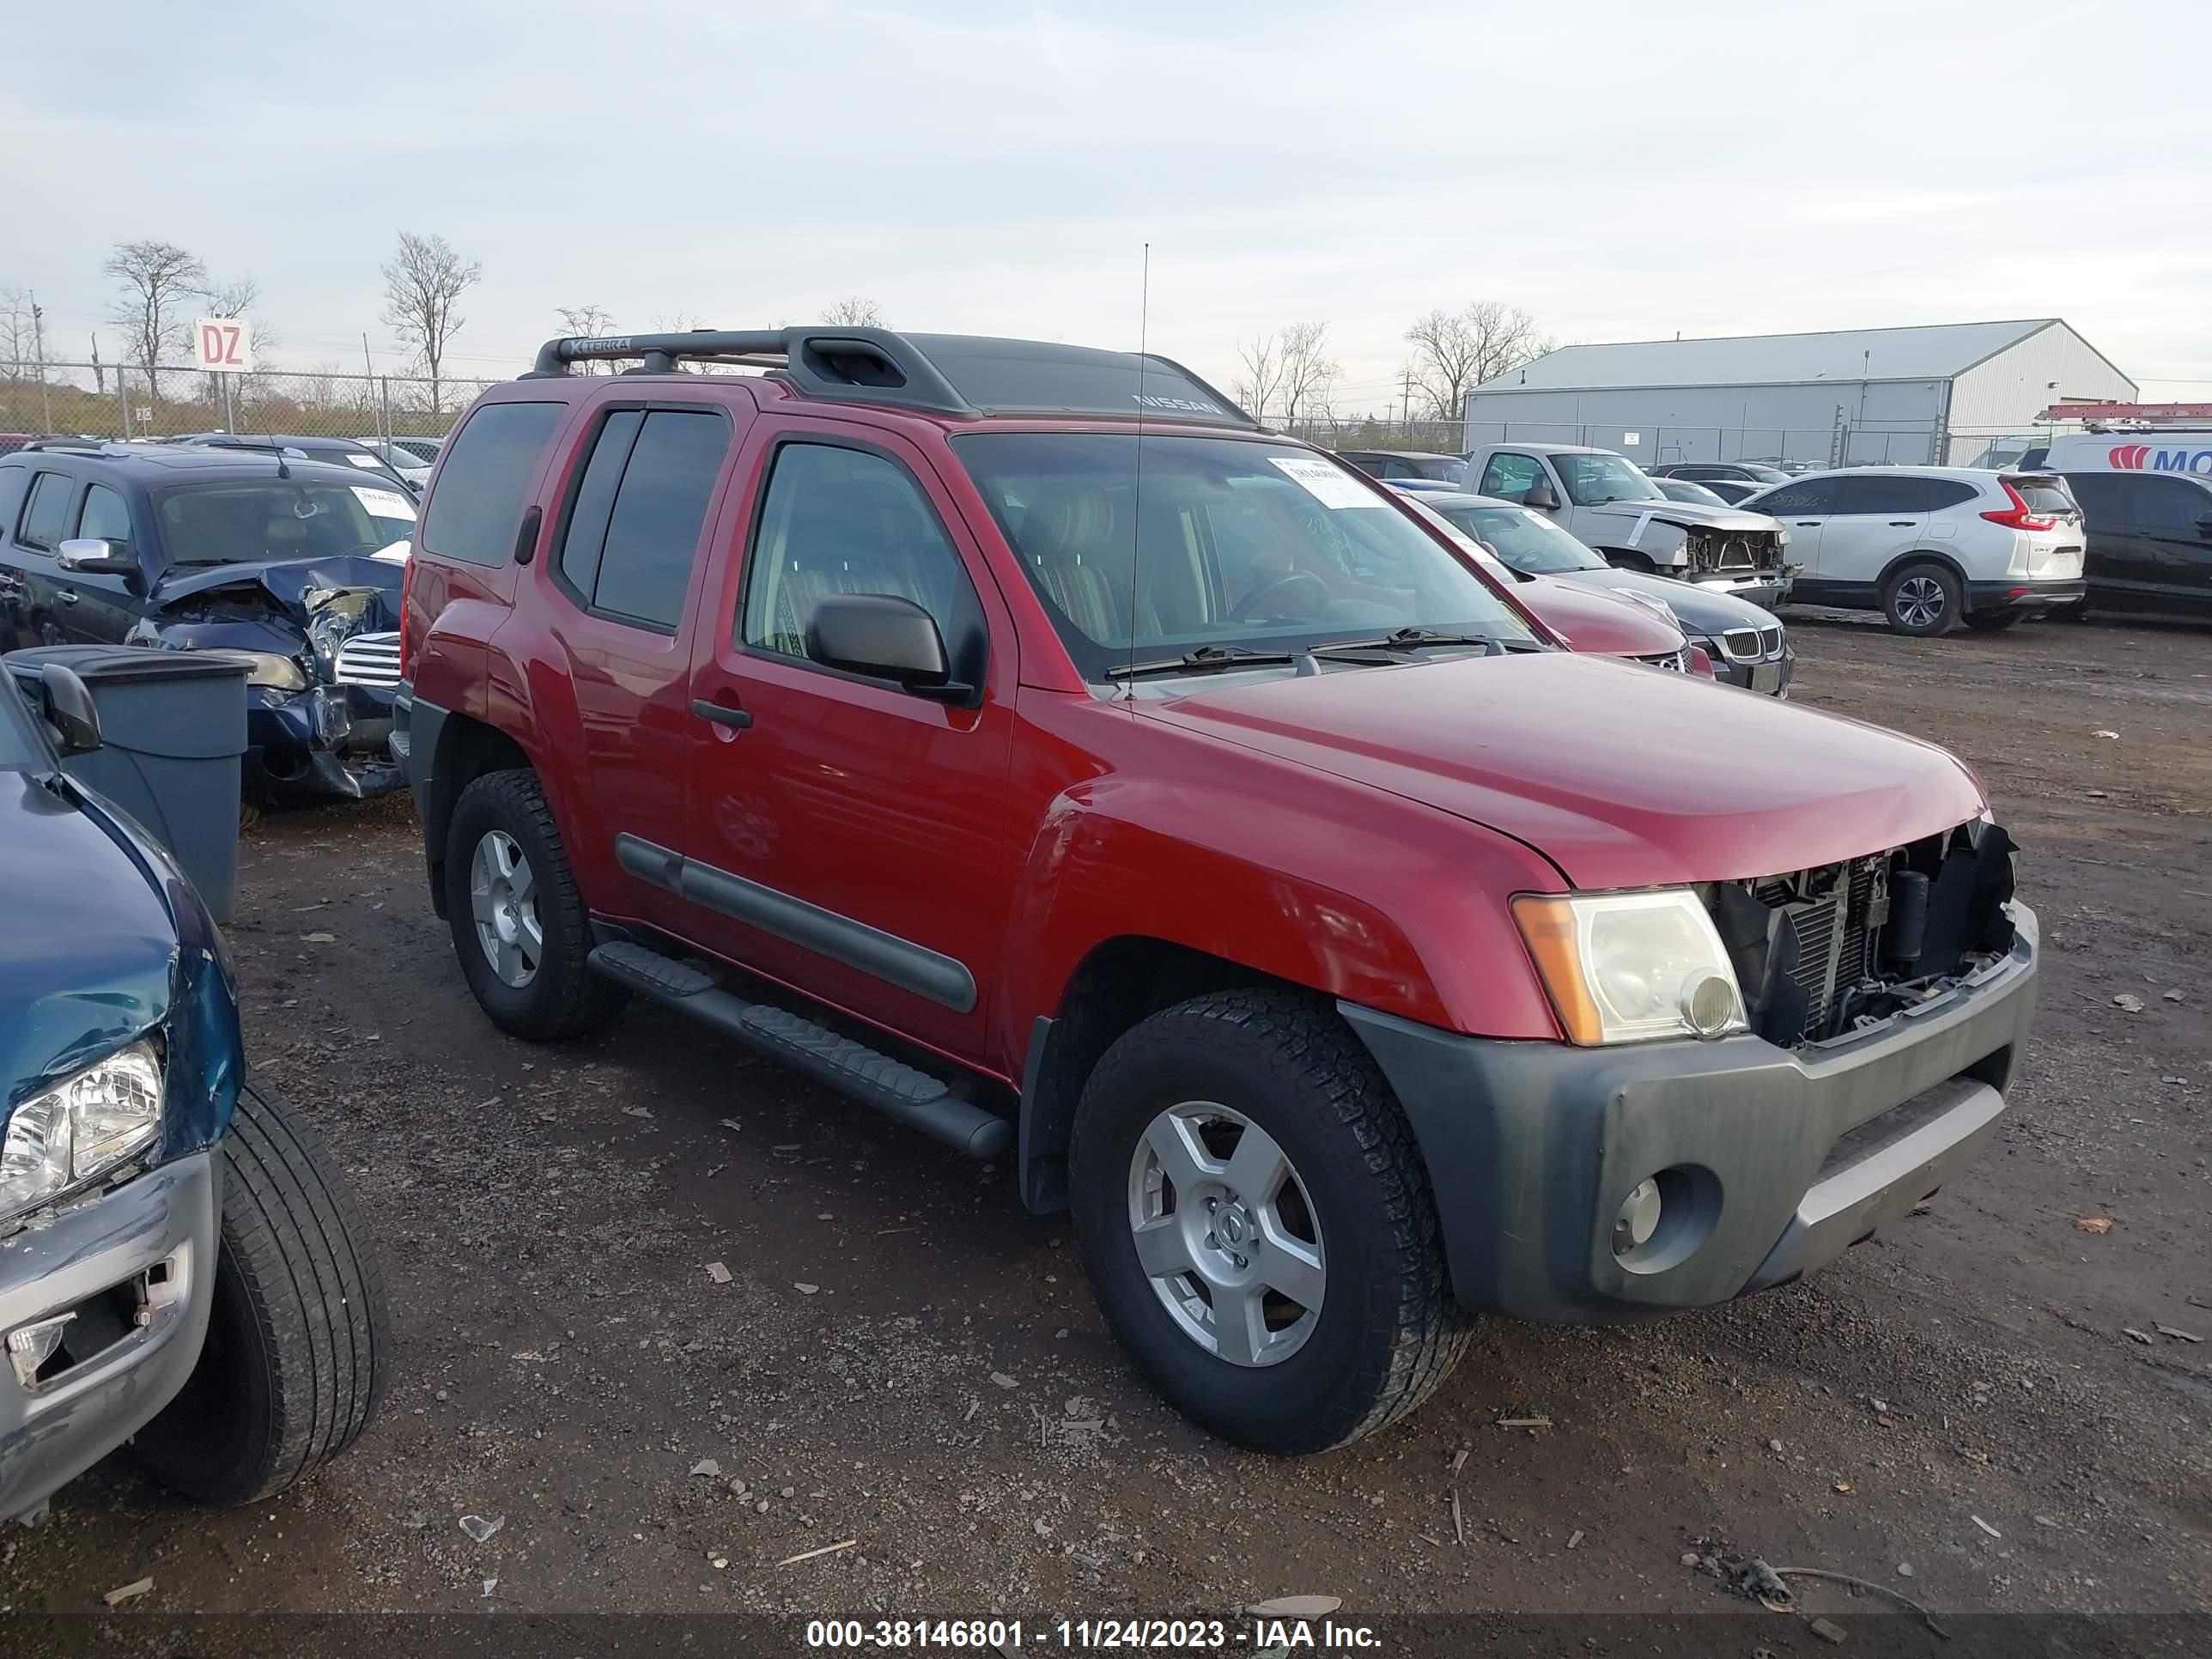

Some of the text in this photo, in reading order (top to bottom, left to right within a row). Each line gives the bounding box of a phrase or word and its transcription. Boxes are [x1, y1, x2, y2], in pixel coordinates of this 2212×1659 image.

[202, 325, 243, 366] DZ
[570, 338, 632, 355] XTERRA
[1132, 394, 1224, 415] NISSAN
